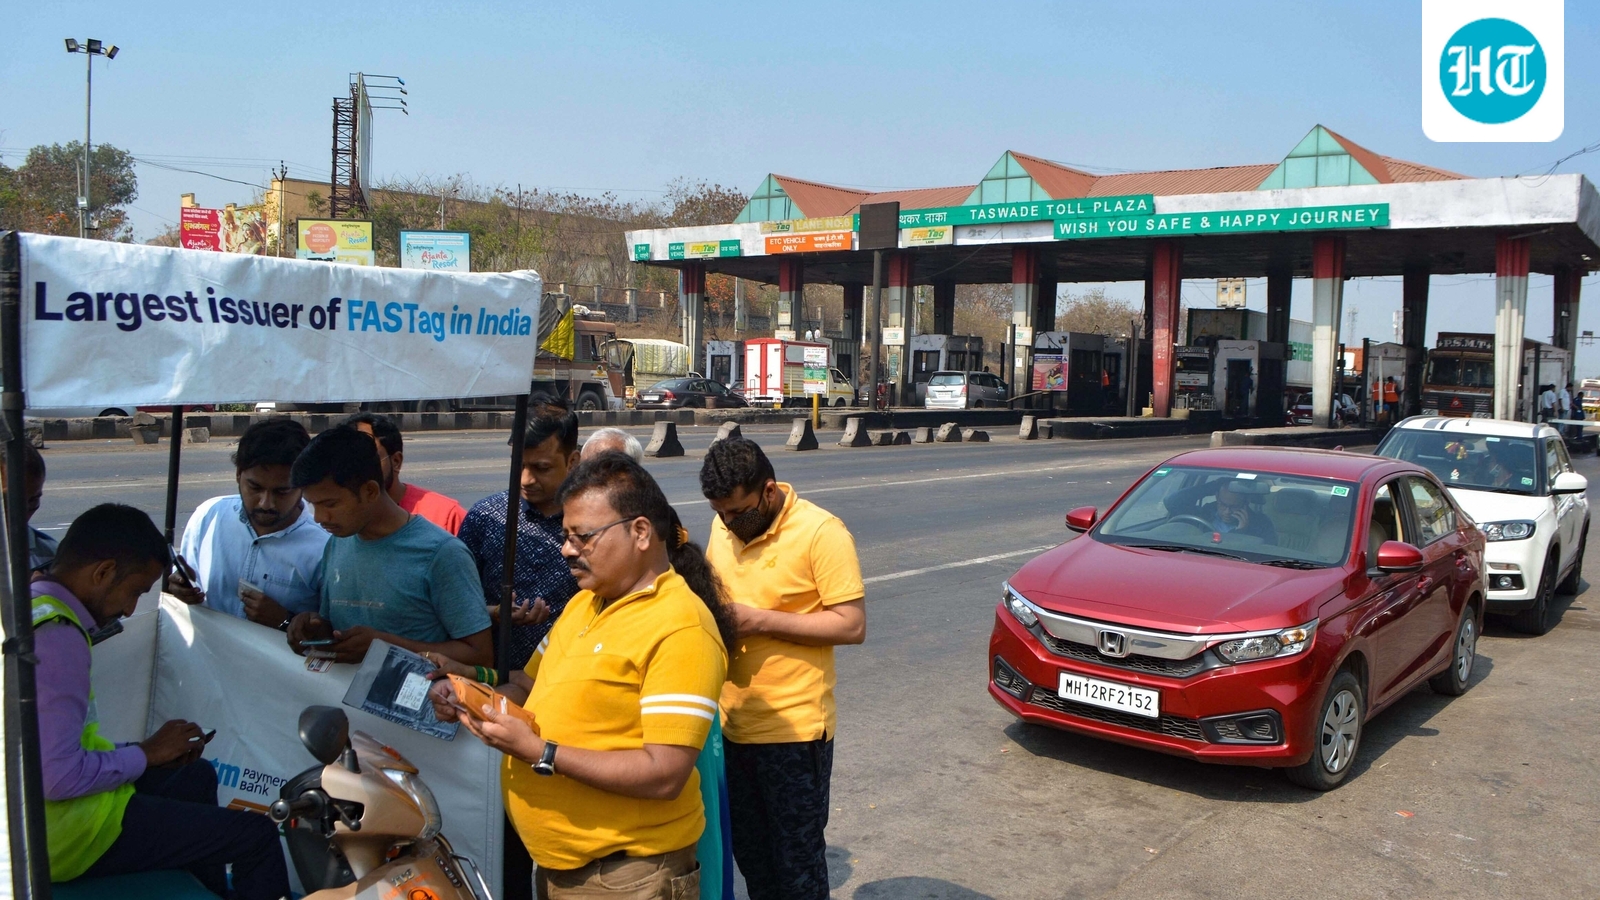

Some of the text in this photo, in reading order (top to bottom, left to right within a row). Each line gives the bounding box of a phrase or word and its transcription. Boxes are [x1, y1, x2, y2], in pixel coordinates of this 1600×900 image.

[970, 199, 1147, 220] TASWADE TOLL PLAZA
[796, 220, 823, 231] LANE
[899, 212, 947, 225] थकर नाका
[1059, 208, 1380, 235] WISH YOU SAFE & HAPPY JOURNEY
[783, 236, 807, 244] VEHICLE
[421, 250, 448, 263] Ajanta
[432, 258, 458, 269] Resort
[35, 281, 532, 342] Largest issuer of FASTag in India
[1065, 679, 1152, 711] MH12RF2152
[243, 768, 289, 788] Paymen
[239, 780, 270, 796] Bank
